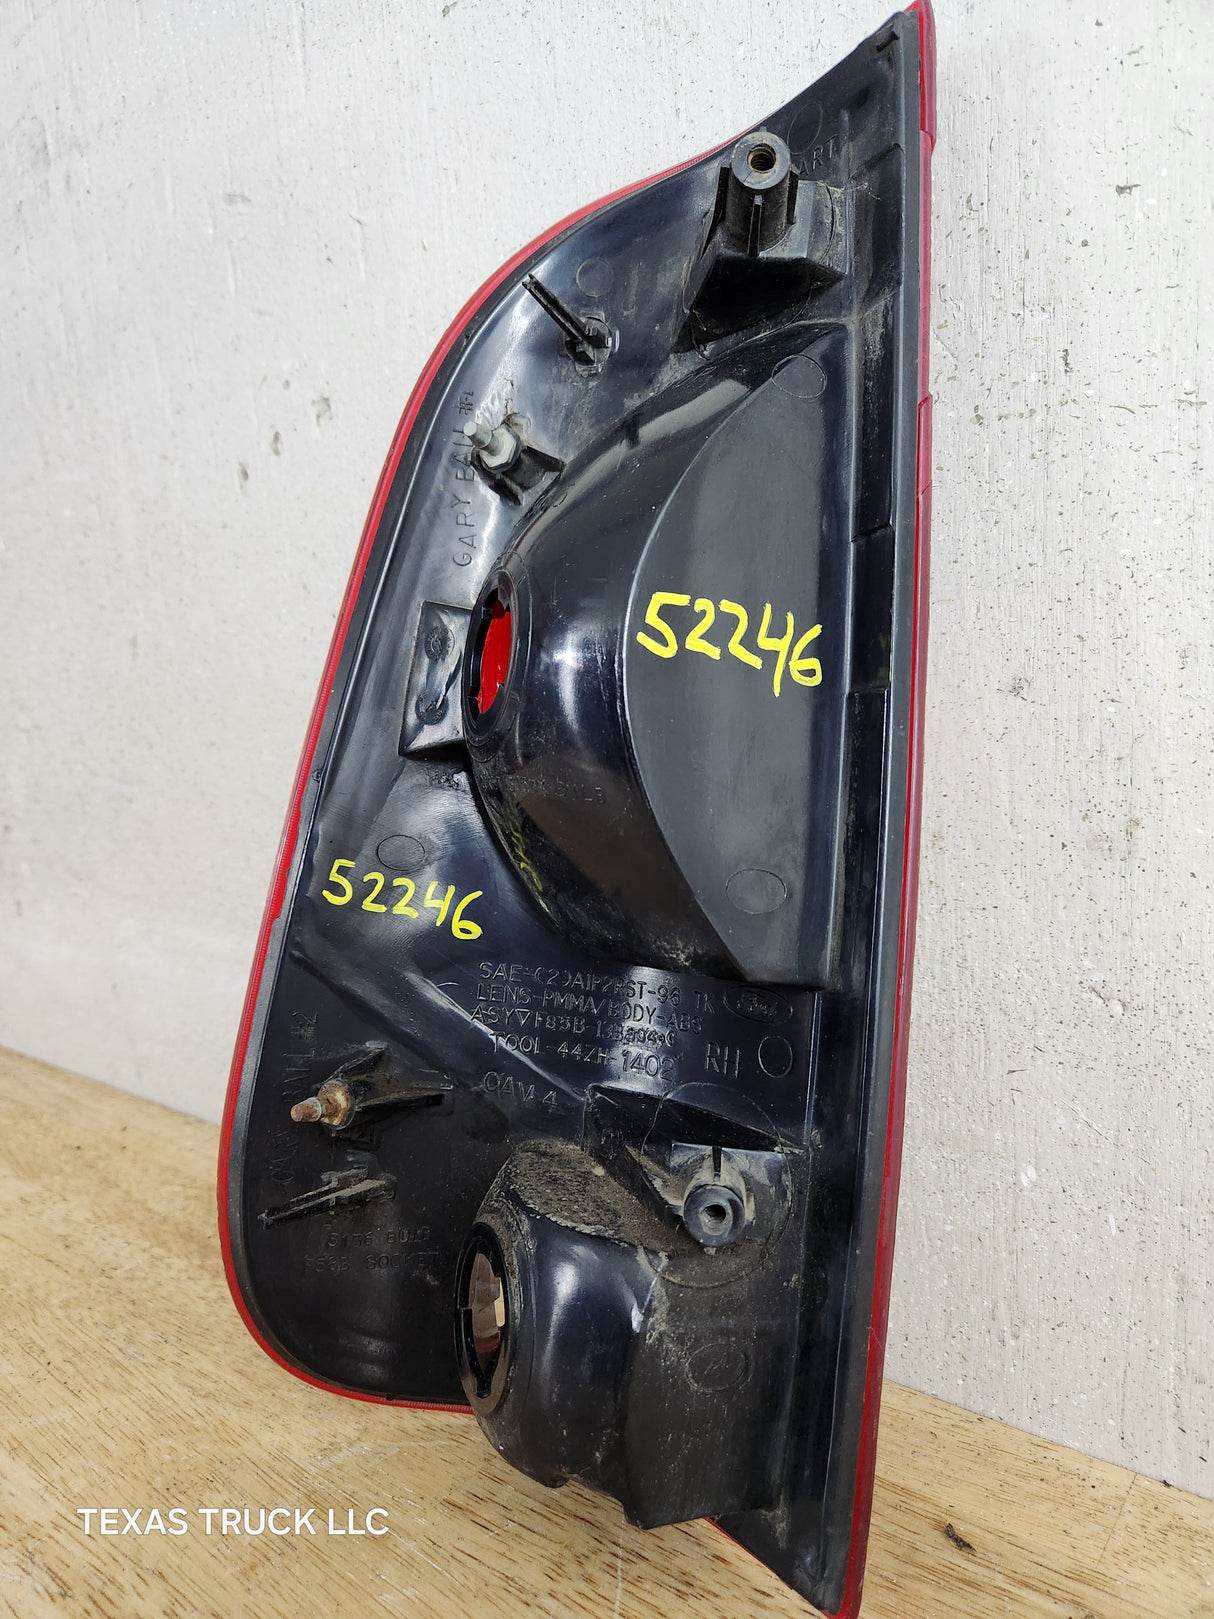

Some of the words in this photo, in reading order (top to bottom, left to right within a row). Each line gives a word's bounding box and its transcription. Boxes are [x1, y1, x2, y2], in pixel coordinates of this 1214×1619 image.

[452, 495, 477, 567] GARY
[636, 592, 822, 697] 52246
[322, 859, 483, 940] 52246
[704, 1041, 741, 1079] RH
[365, 1251, 441, 1271] SOCKET
